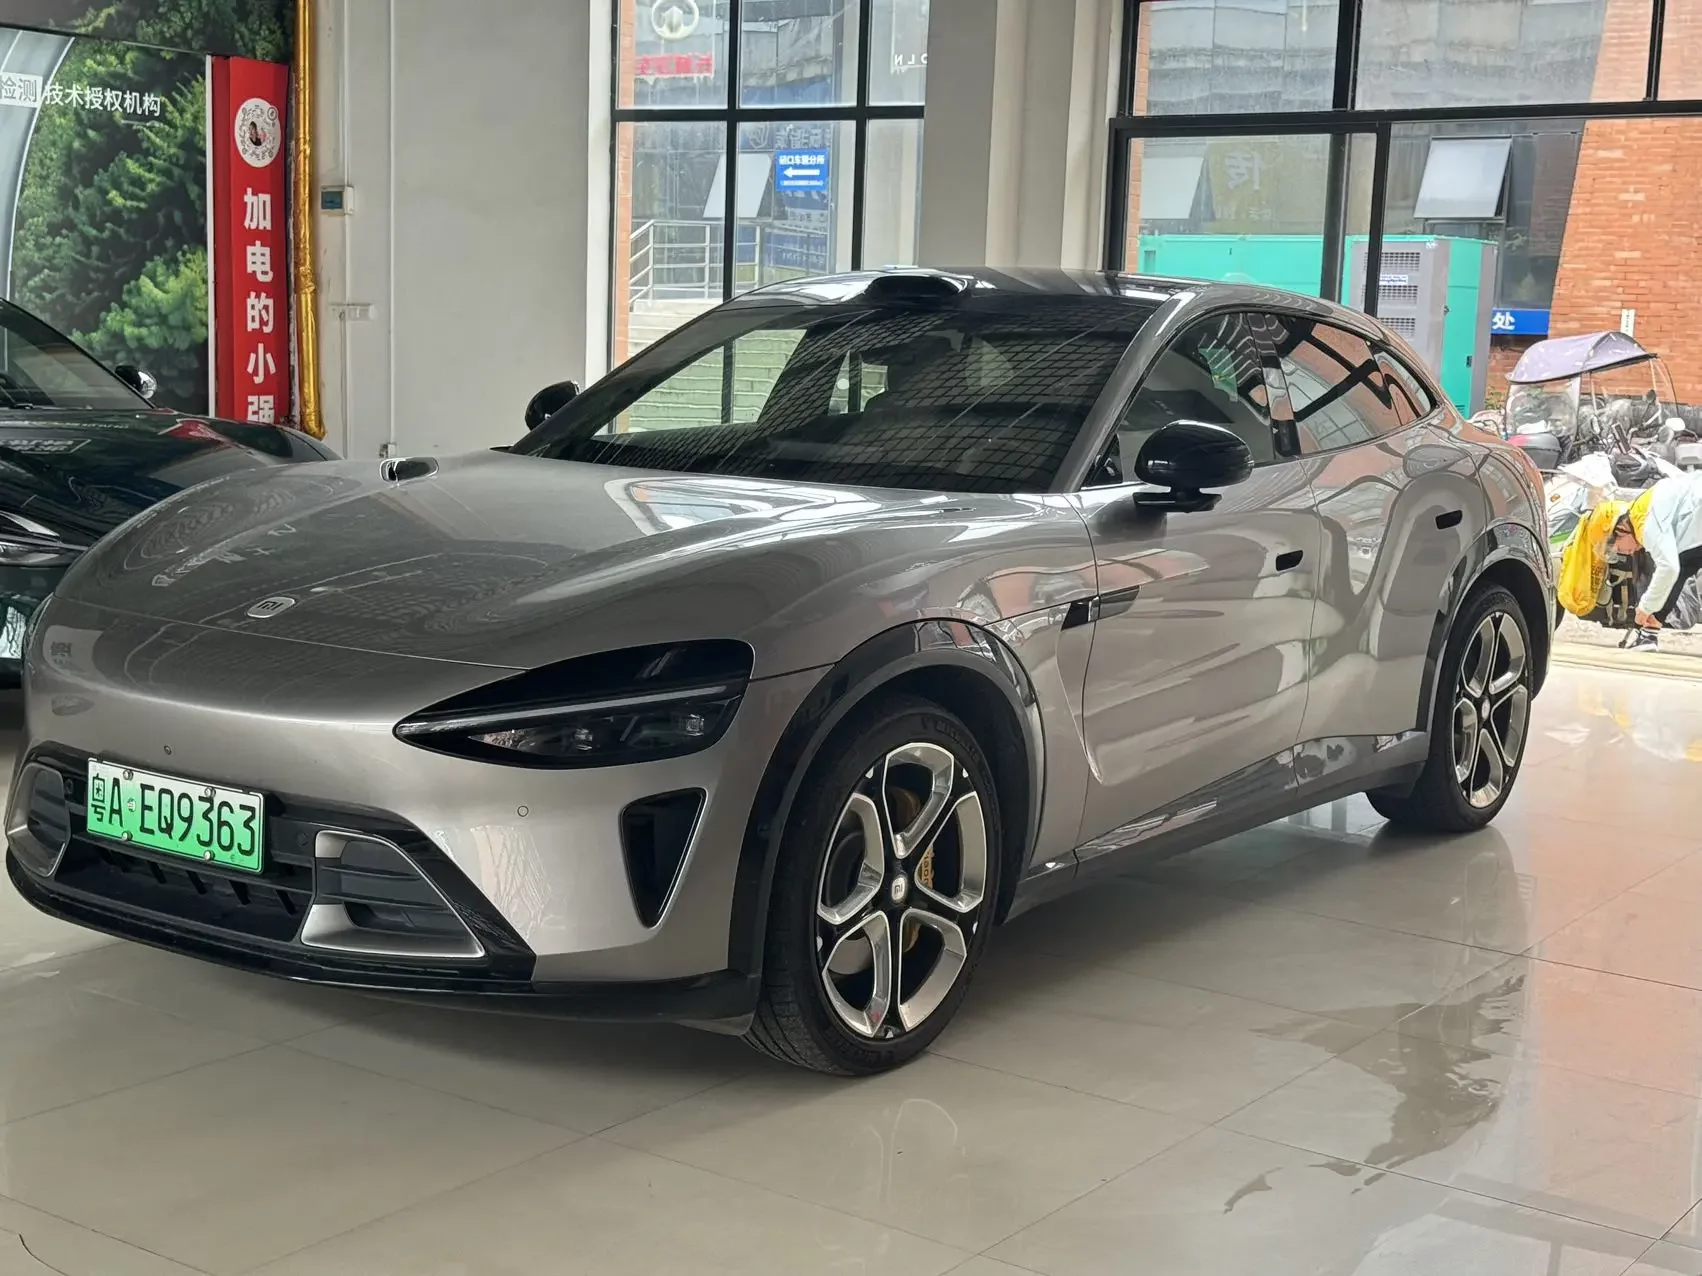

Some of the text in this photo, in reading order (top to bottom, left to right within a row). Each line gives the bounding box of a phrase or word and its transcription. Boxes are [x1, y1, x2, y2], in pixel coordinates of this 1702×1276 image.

[0, 76, 161, 117] 检测 技术授权机构
[243, 187, 277, 424] 加电的小强
[139, 783, 257, 856] EQ9363
